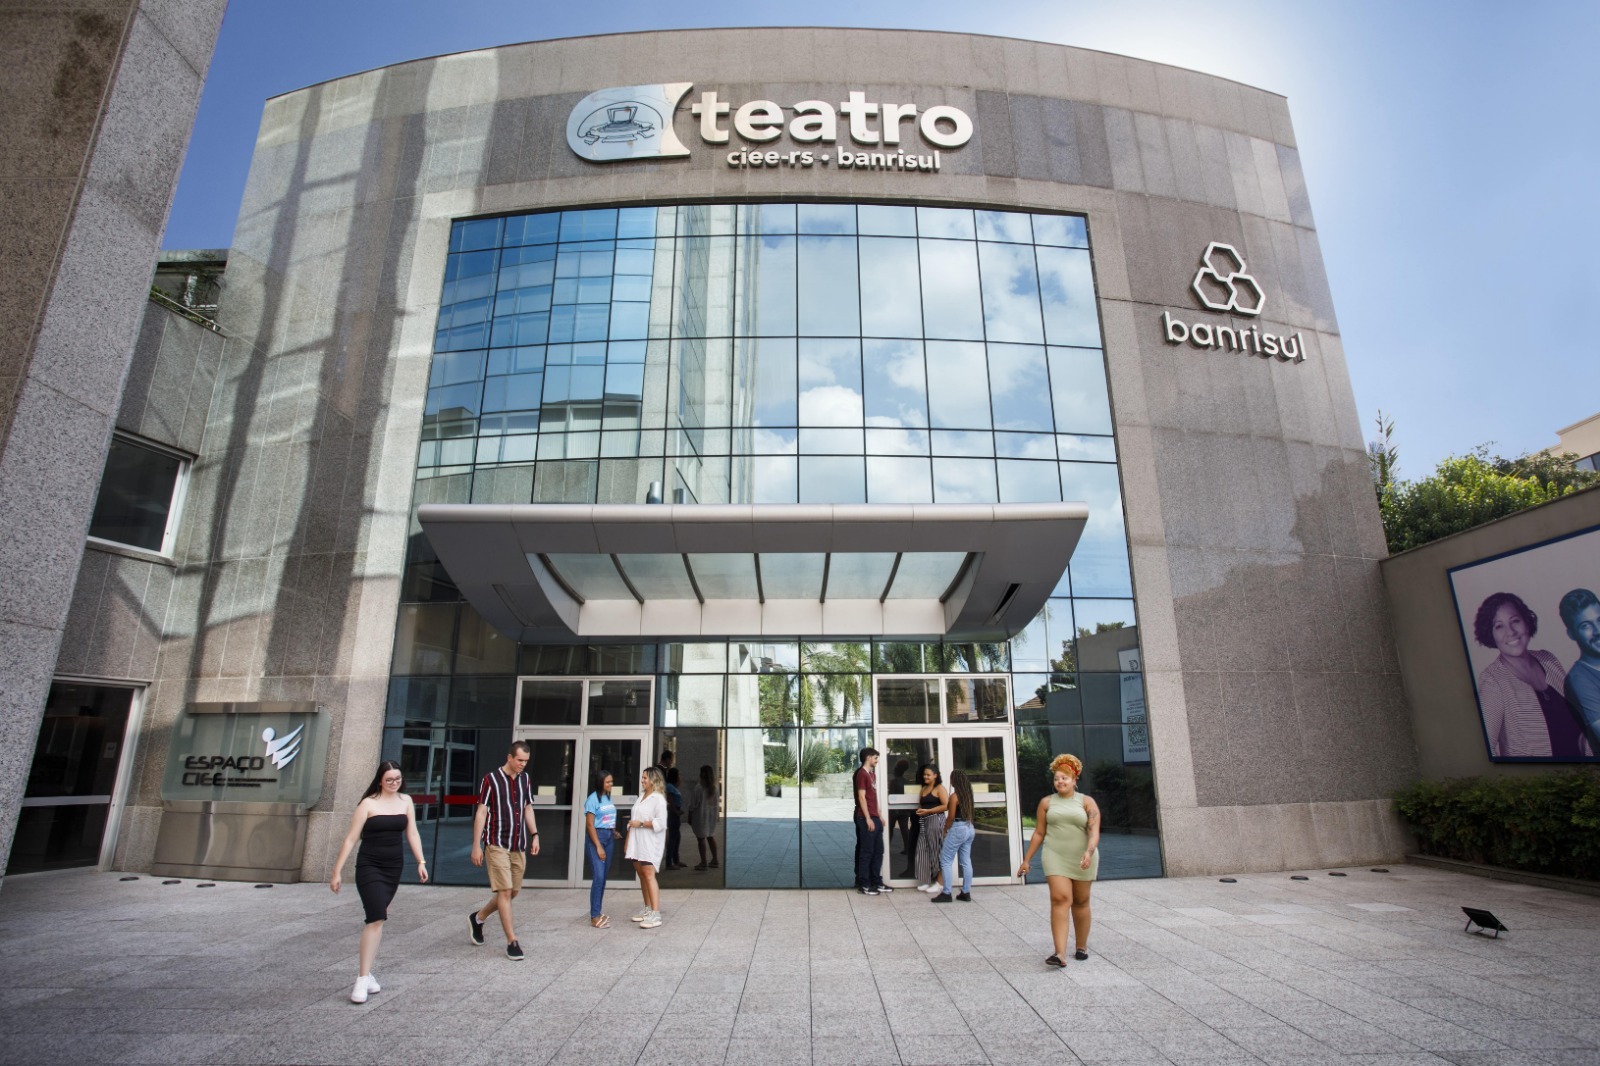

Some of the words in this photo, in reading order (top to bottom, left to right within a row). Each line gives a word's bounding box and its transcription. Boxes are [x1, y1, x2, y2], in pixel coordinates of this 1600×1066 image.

[692, 91, 973, 149] teatro
[726, 147, 814, 169] ciee-rs
[837, 146, 941, 172] banrisul
[1162, 311, 1307, 363] banrisul
[185, 755, 265, 773] ESPAÇO
[182, 772, 226, 787] CIEE
